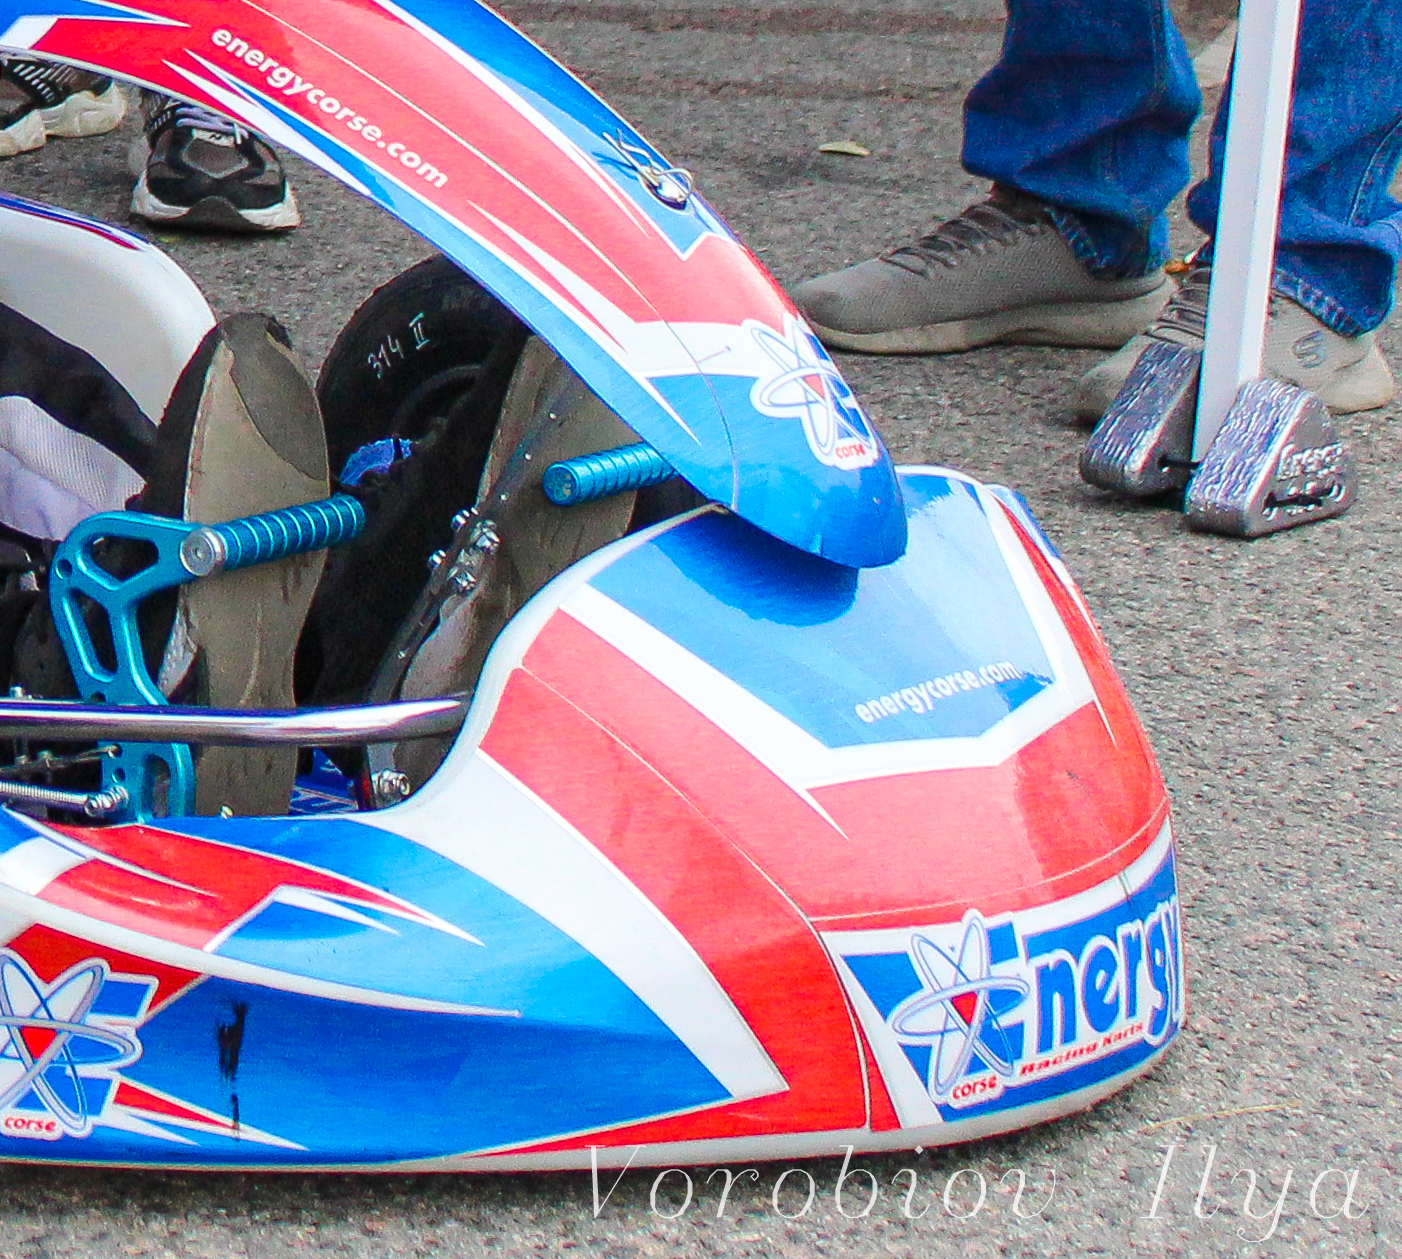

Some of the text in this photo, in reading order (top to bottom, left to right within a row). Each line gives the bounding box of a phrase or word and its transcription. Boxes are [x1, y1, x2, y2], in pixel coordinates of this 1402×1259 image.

[210, 27, 449, 189] energycorse.com
[854, 660, 1023, 725] energycorse.com
[1019, 1022, 1144, 1076] Racing Karts
[951, 1075, 999, 1100] corse
[3, 1115, 57, 1133] corse
